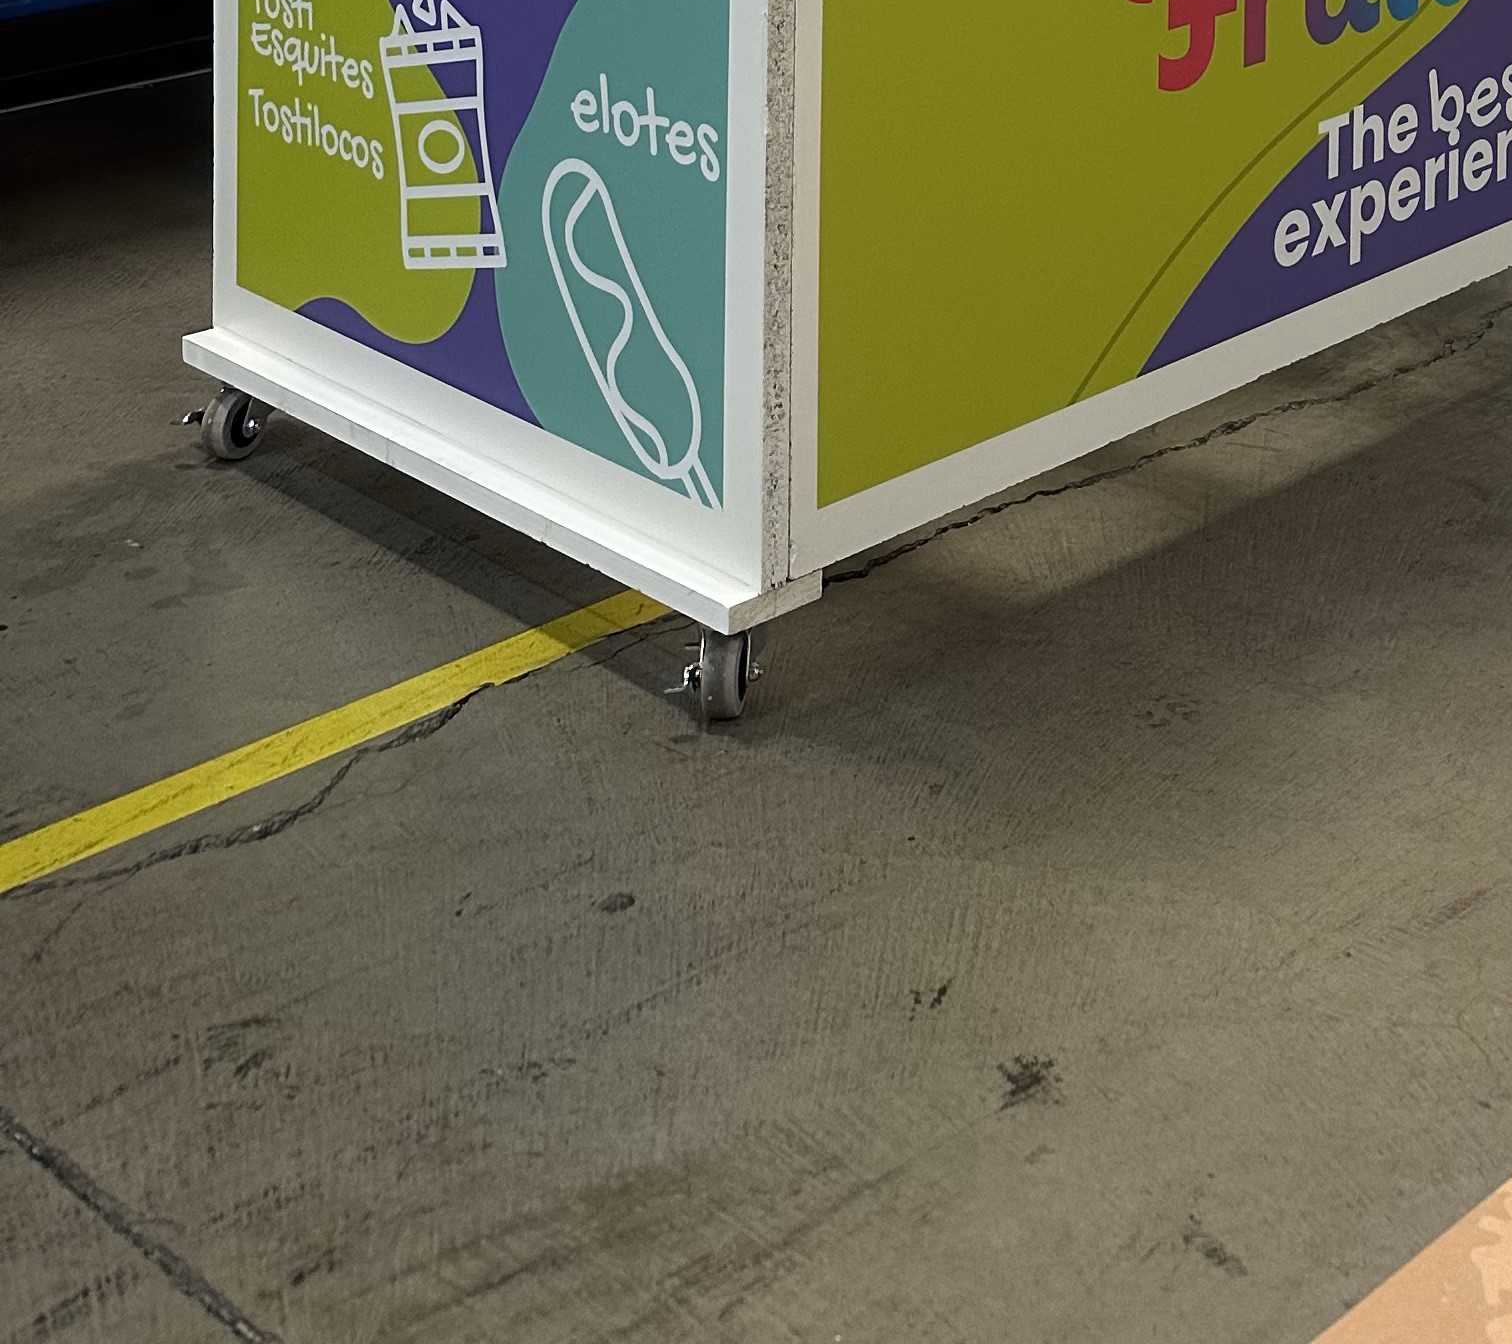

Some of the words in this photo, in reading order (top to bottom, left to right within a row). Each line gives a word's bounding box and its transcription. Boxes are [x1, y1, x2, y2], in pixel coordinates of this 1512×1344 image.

[250, 22, 375, 100] Esquites
[248, 88, 385, 181] Tostilocos
[570, 72, 721, 183] elotes
[1317, 103, 1418, 180] The
